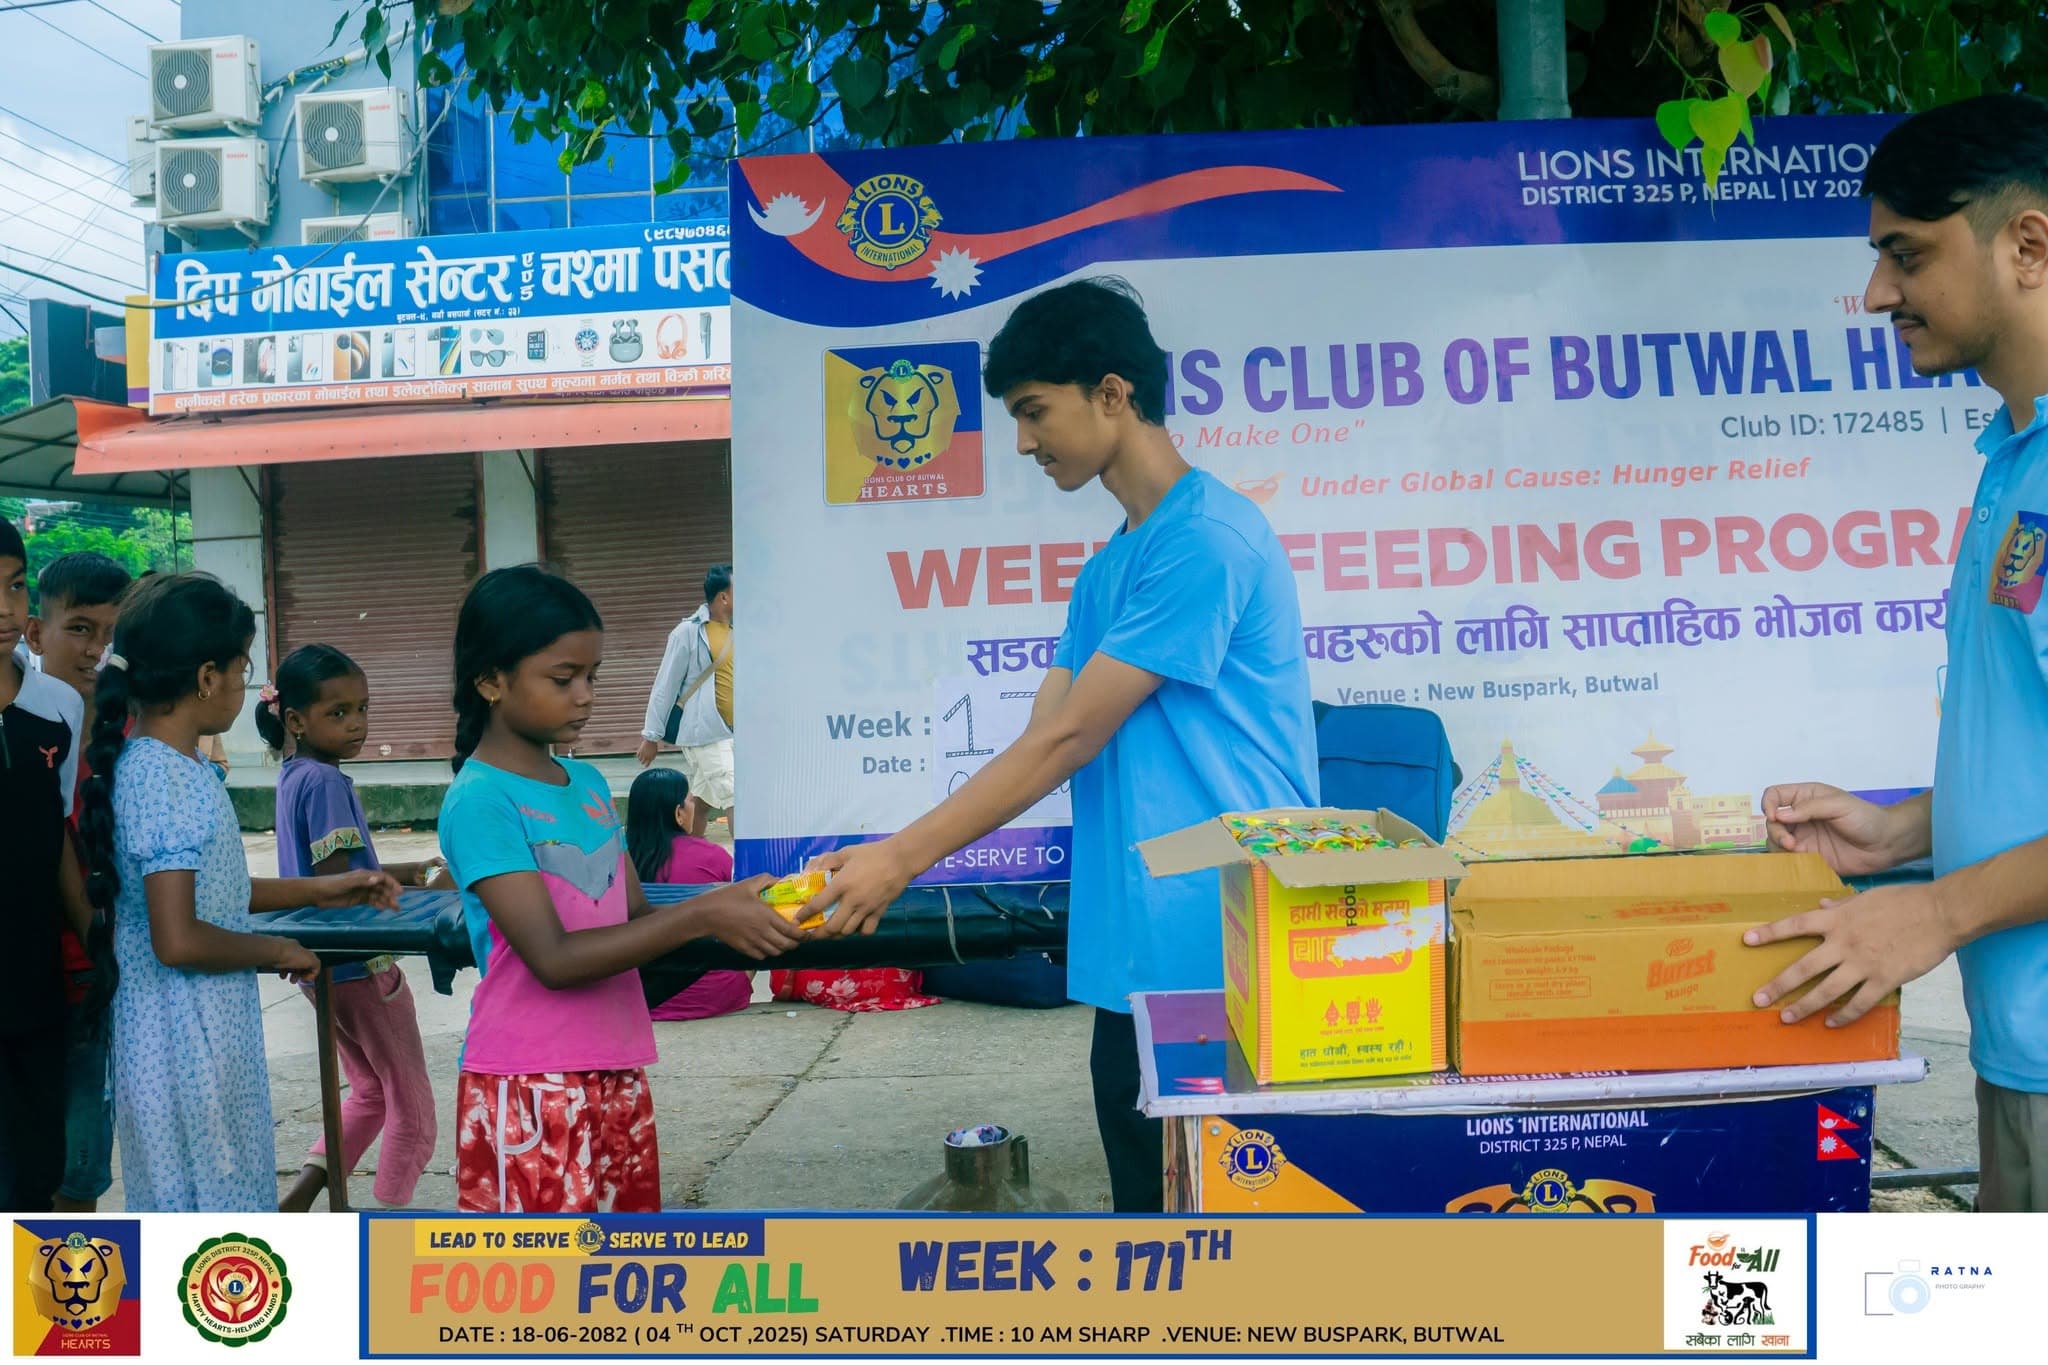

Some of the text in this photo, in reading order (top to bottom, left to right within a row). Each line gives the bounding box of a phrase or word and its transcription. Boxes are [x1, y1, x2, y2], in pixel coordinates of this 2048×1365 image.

[1518, 143, 1877, 182] LIONS INTRNATIO
[858, 176, 920, 198] LIONS
[1522, 185, 1626, 206] DISTRICT
[1633, 183, 1674, 204] 325
[1680, 182, 1697, 204] P,
[1704, 181, 1776, 202] NEPAL
[1793, 180, 1818, 199] LY
[1824, 179, 1863, 198] 202
[878, 202, 906, 236] L
[643, 224, 730, 242] (९८५७०४६
[860, 243, 921, 263] INTERNATIONAL
[175, 259, 241, 322] दिप
[251, 252, 395, 318] मोबाईल
[405, 245, 516, 309] सेन्टर
[541, 248, 641, 299] चश्मा
[1243, 341, 1425, 413] CLUB
[1444, 336, 1530, 405] OF
[1549, 328, 1832, 401] BUTWAL
[229, 391, 258, 407] हरेक
[262, 389, 311, 405] प्रकारका
[315, 383, 361, 400] मोबाईल
[365, 384, 388, 399] तथा
[472, 379, 513, 393] सामान
[635, 372, 660, 385] तथा
[1721, 414, 1781, 438] Club
[1790, 413, 1825, 437] ID:
[1832, 410, 1924, 435] 172485
[1965, 408, 2000, 430] Es
[1196, 424, 1280, 450] Make
[861, 482, 948, 499] HEARTS
[886, 475, 904, 483] CLUB
[1300, 457, 1812, 498] Under Global Cause: Hunger Relief
[886, 540, 1110, 609] WEE
[1277, 519, 1641, 592] FEEDING
[1454, 603, 1551, 656] लागि
[1562, 597, 1742, 650] साप्ताहिक
[1753, 593, 1862, 639] भोजन
[1337, 687, 1406, 704] Venue
[1427, 681, 1476, 701] New
[1482, 675, 1578, 701] Buspark,
[1584, 672, 1660, 694] Butwal
[826, 710, 913, 740] Week
[862, 756, 912, 774] Date
[934, 846, 1065, 869] E-SERVE TO
[1466, 1111, 1649, 1137] LIONS INTERNATIONAL
[1233, 1131, 1271, 1145] LIONS
[1480, 1135, 1627, 1154] DISTRICT 325 P, NEPAL
[1245, 1147, 1263, 1170] L
[1533, 1170, 1566, 1182] LIONS
[1543, 1183, 1558, 1202] L
